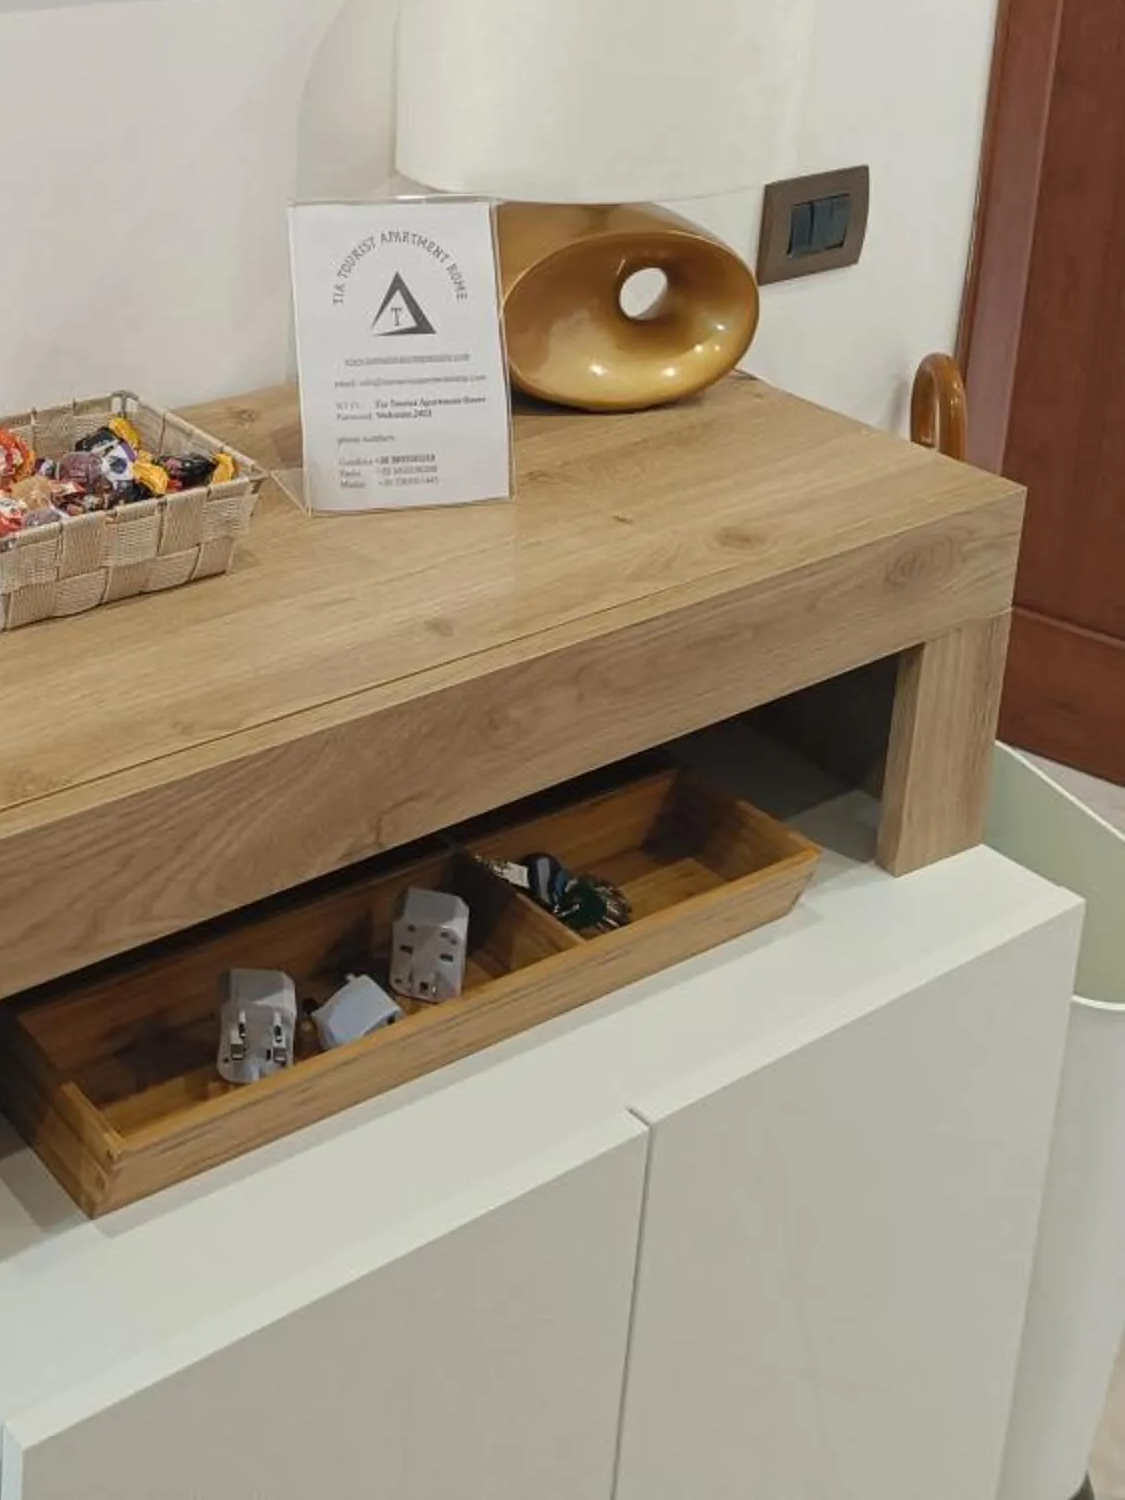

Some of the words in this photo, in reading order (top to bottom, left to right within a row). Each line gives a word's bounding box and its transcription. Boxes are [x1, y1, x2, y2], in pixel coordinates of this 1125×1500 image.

[337, 236, 376, 279] TOURIST
[380, 230, 450, 264] APARTMENT
[333, 281, 345, 306] TIA
[446, 262, 468, 301] ROME
[390, 307, 403, 326] T
